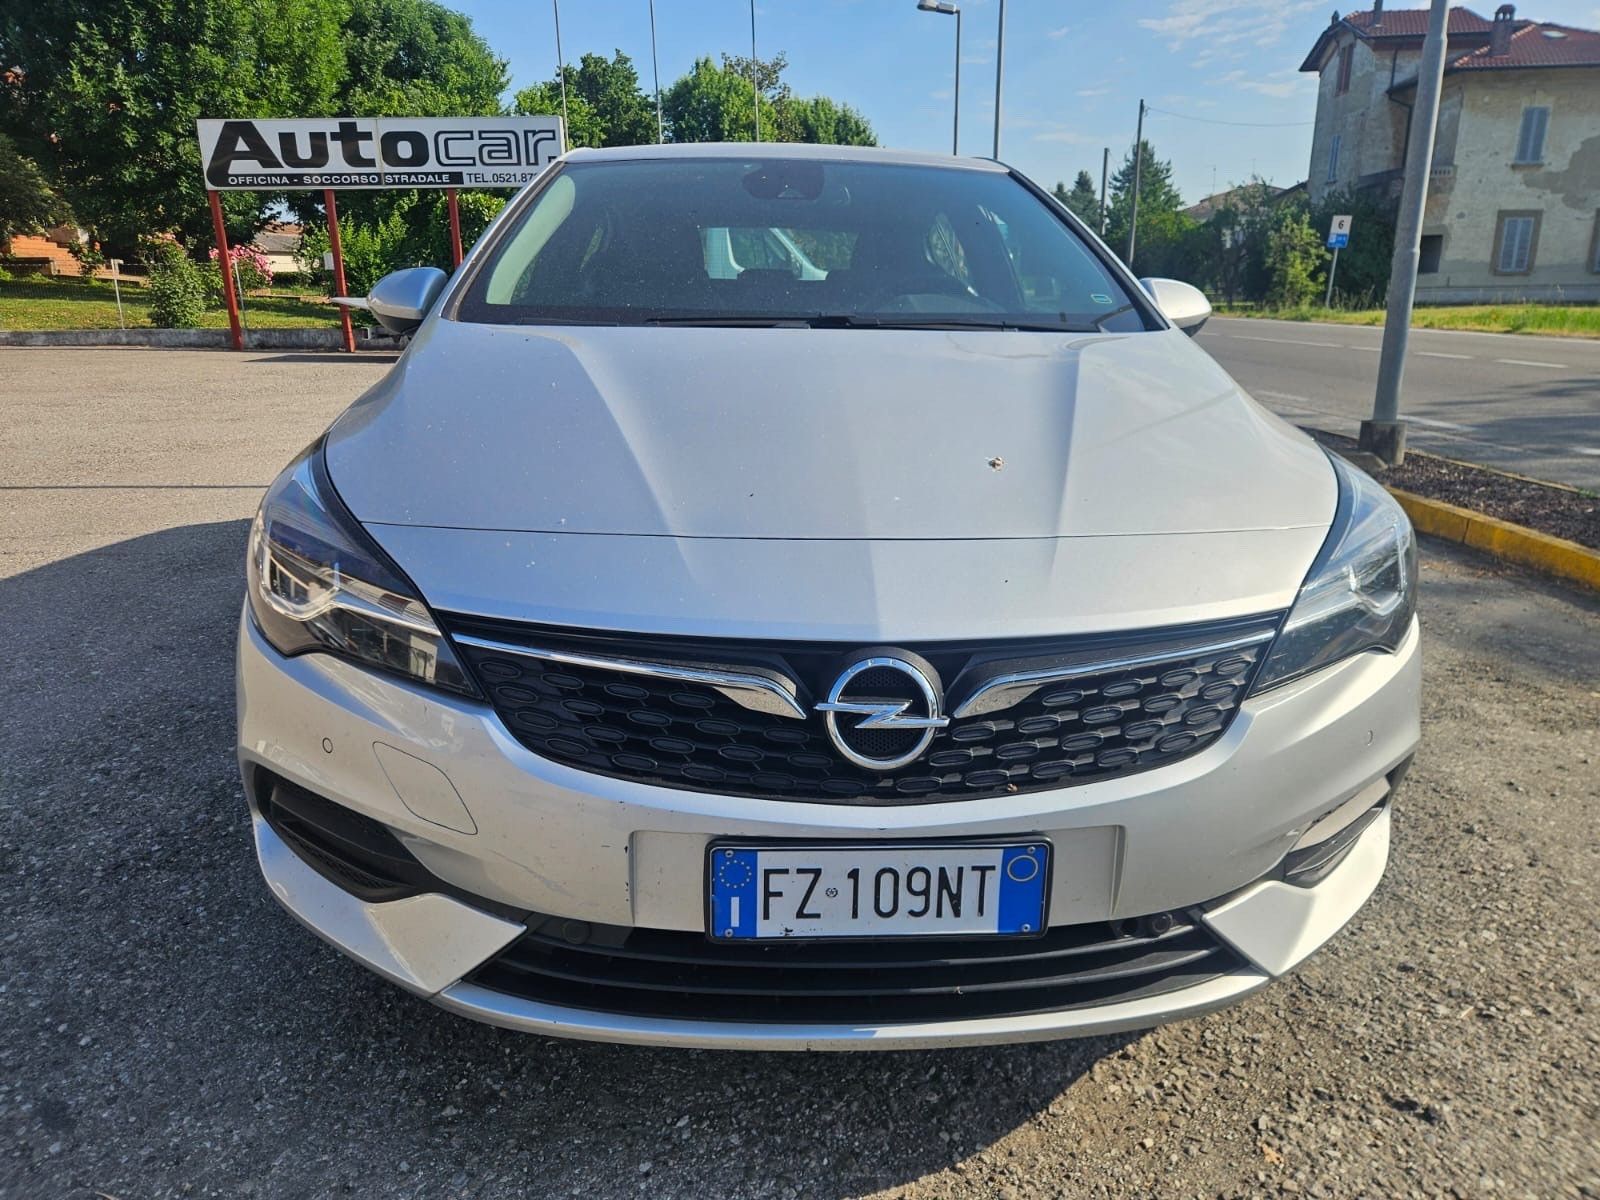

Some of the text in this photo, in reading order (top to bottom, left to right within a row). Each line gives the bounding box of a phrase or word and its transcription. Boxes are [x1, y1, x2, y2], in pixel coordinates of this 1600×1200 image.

[228, 176, 290, 185] OFFICINA
[303, 175, 379, 185] SOCCORSO
[385, 174, 450, 183] STRADALE
[1338, 220, 1345, 230] 6
